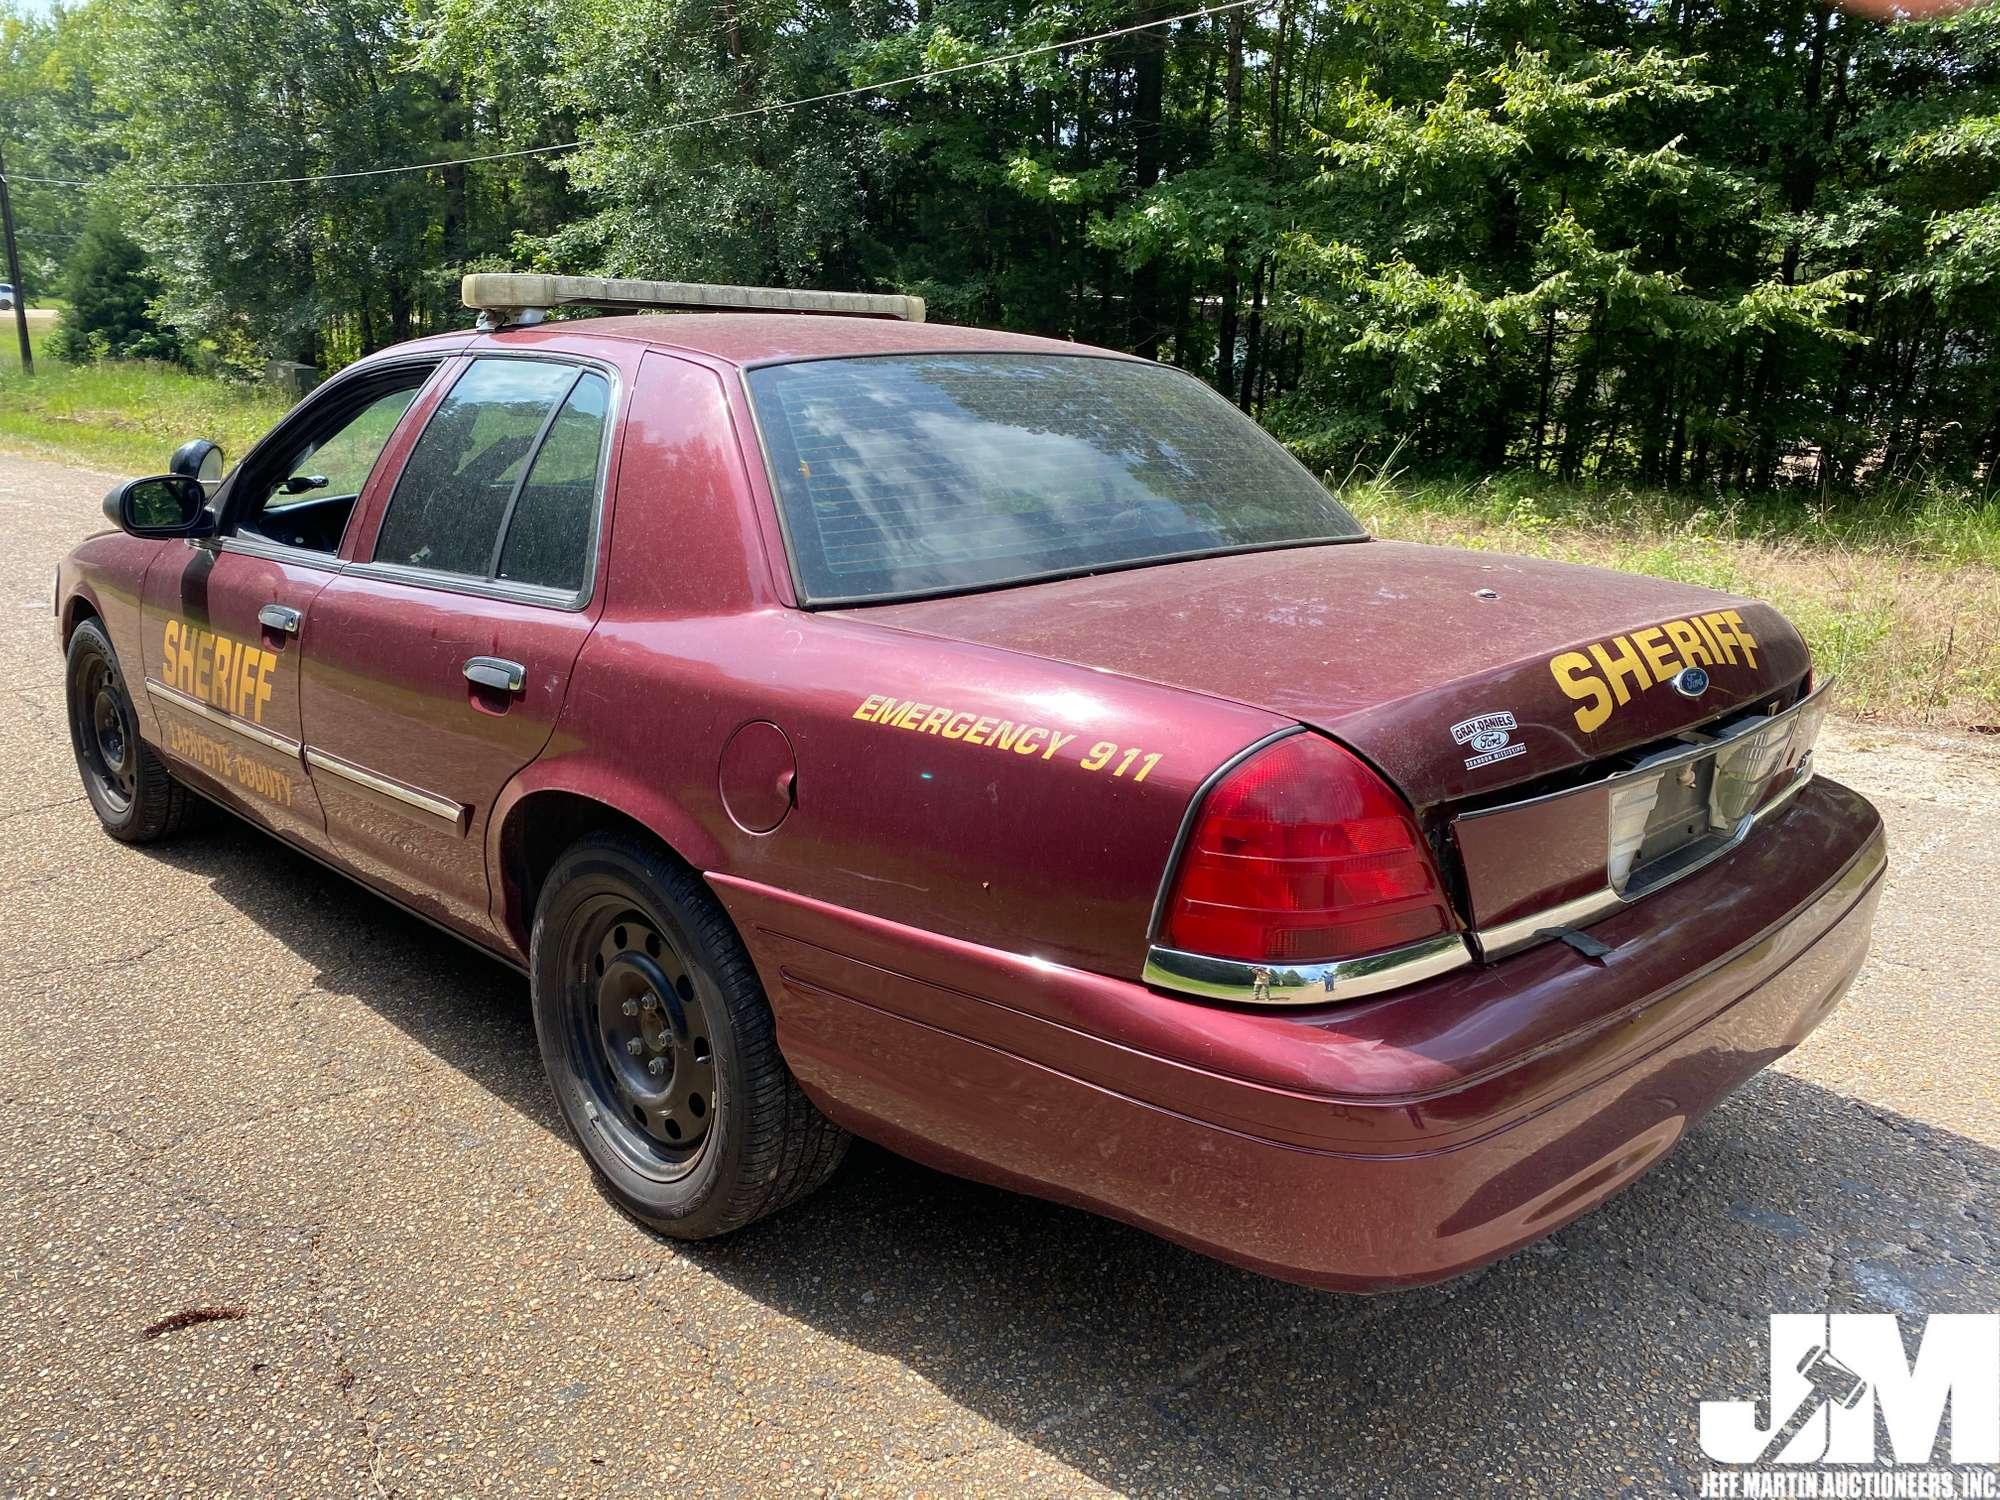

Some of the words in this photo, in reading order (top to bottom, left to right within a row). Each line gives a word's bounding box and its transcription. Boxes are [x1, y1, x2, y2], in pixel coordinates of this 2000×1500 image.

[162, 619, 278, 723] SHERIFF
[1549, 609, 1759, 734] SHERIFF
[169, 721, 232, 777] LAFAYETTE
[236, 755, 294, 806] COUNTY
[852, 693, 1076, 761] EMERGENCY
[1080, 741, 1164, 782] 911
[1480, 732, 1502, 749] Ford
